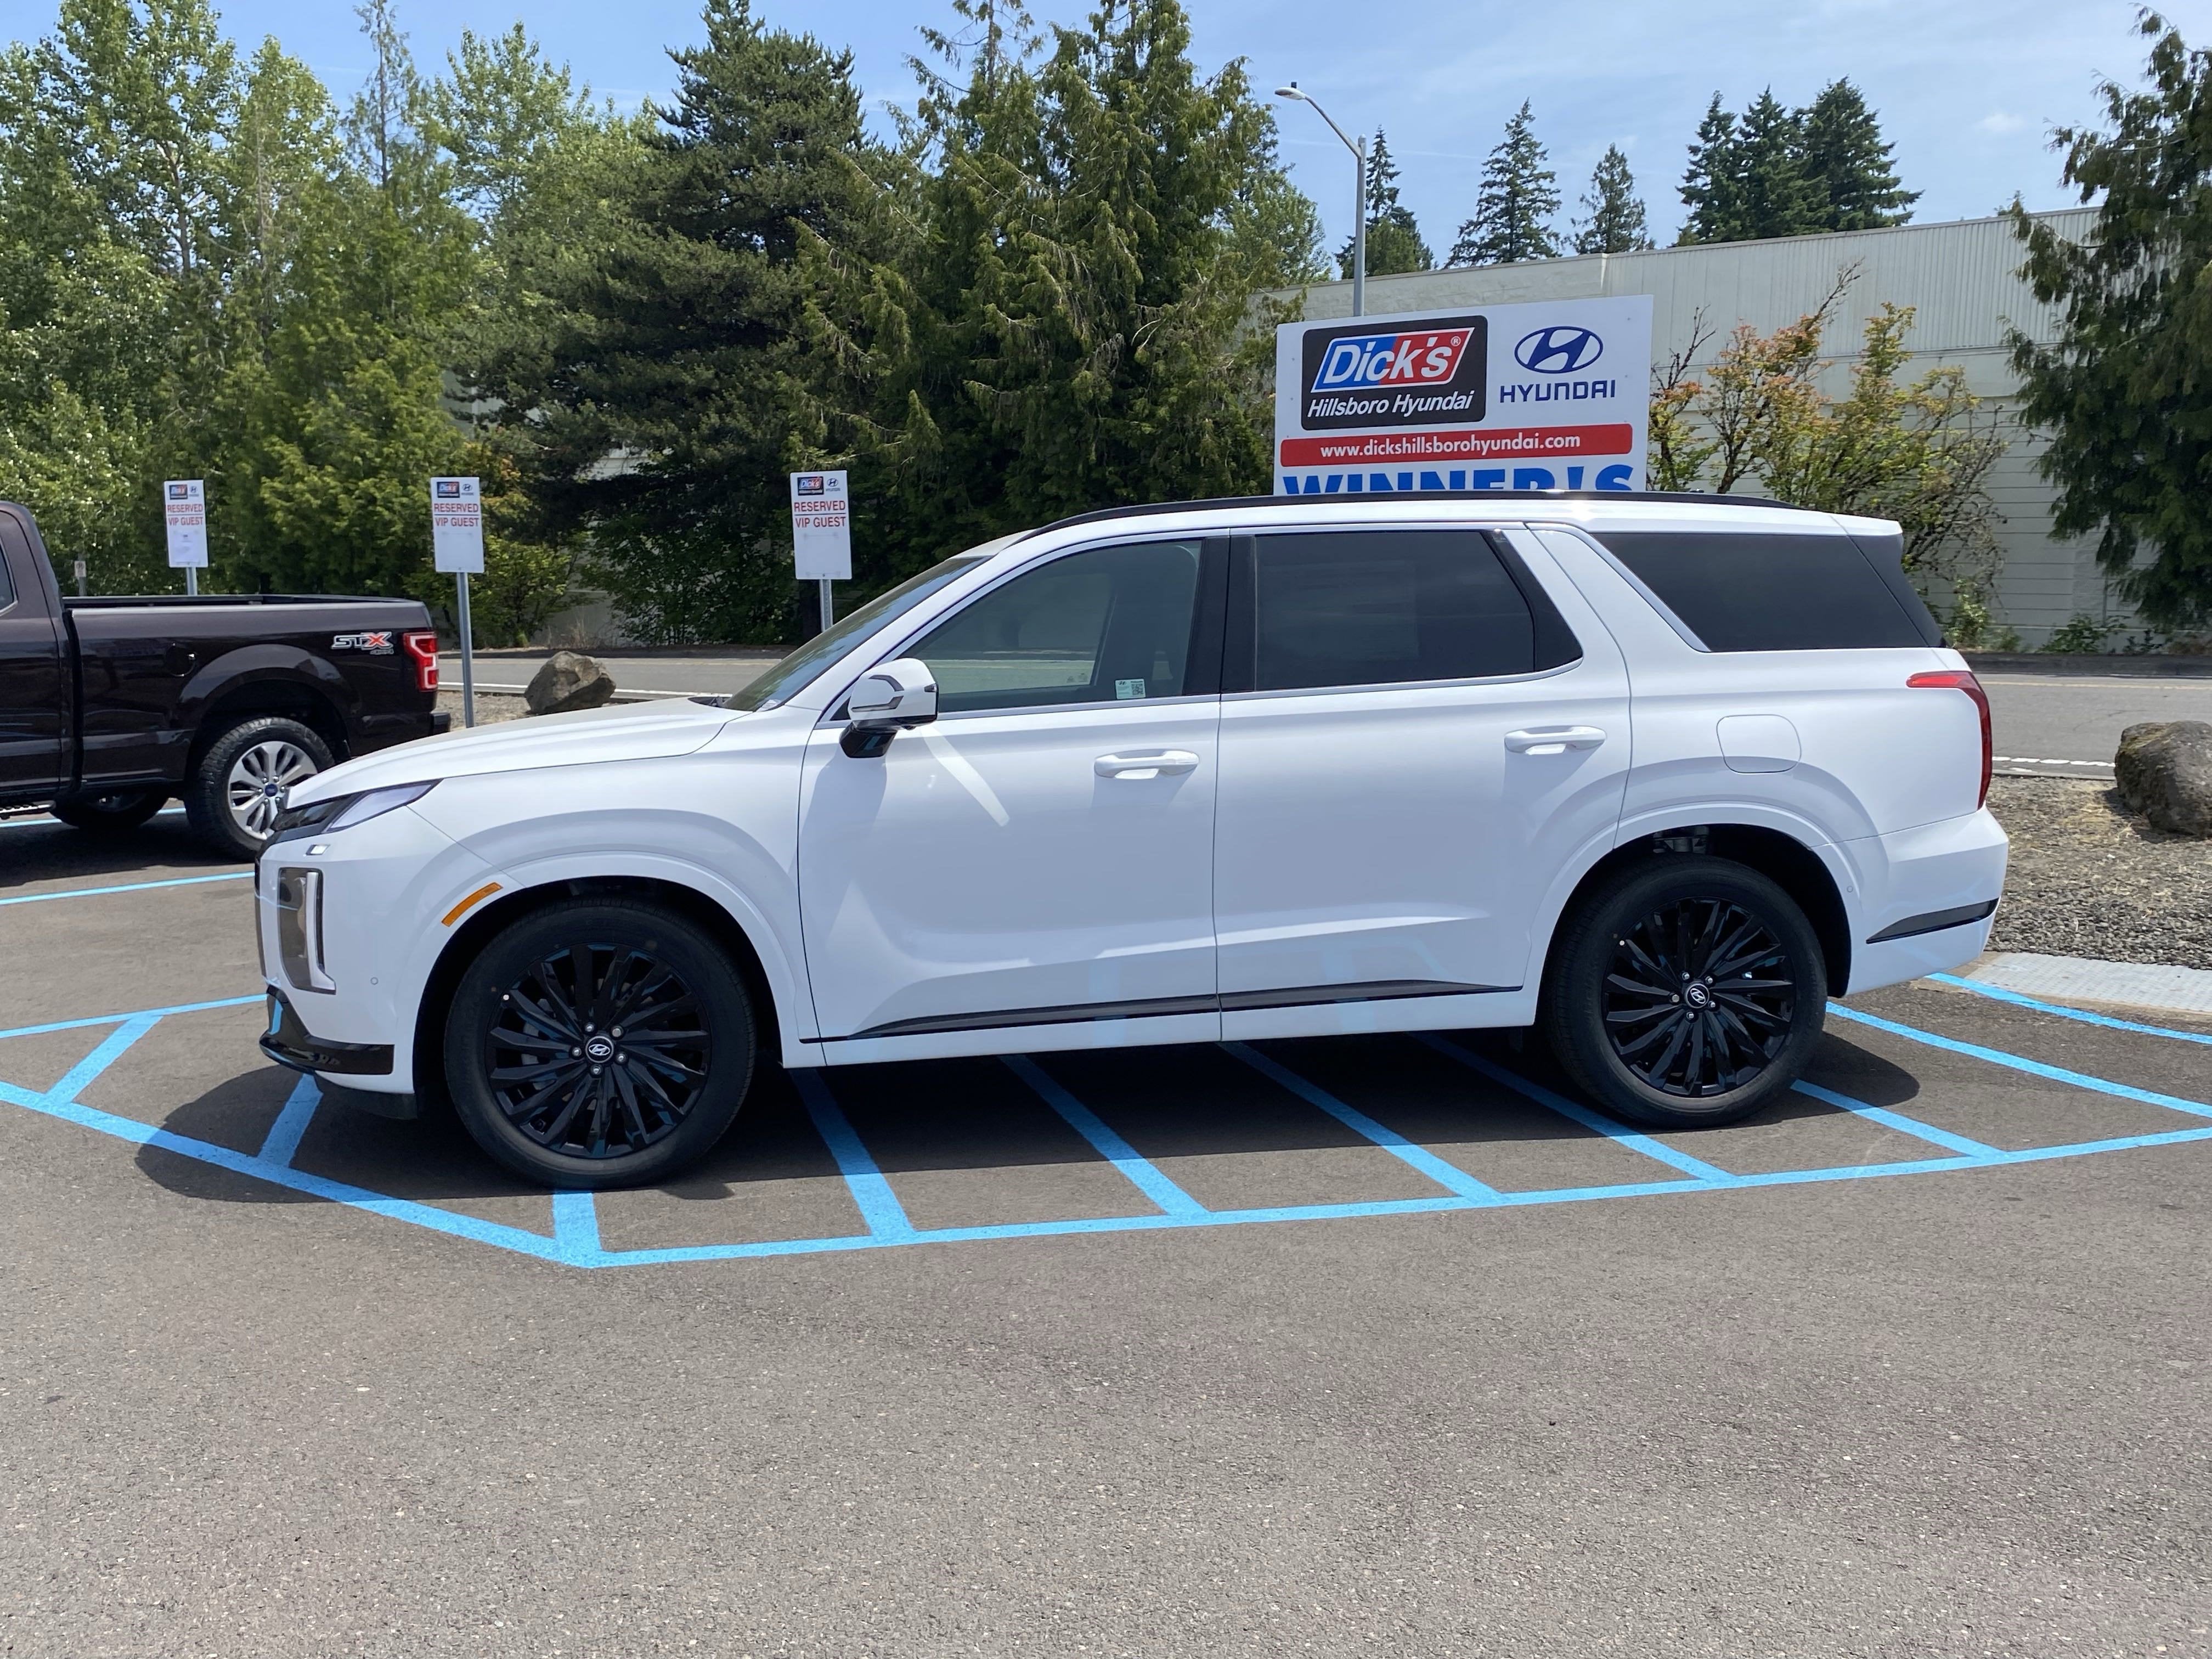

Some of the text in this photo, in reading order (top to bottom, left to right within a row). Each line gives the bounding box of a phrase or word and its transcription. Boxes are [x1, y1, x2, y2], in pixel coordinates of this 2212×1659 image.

[1323, 336, 1452, 384] Dick's
[1500, 379, 1616, 404] HYUNDAI
[1307, 390, 1475, 417] Hillsboro Hyundai
[1321, 432, 1581, 458] www.dickshillsborohyundai.com
[167, 504, 203, 513] RESERVED
[433, 503, 479, 512] RESERVED
[794, 500, 845, 512] RESERVED
[168, 517, 204, 526] VIP GUEST
[435, 517, 479, 527] VIP GUEST
[795, 516, 846, 528] VIP GUEST
[331, 631, 393, 650] STX
